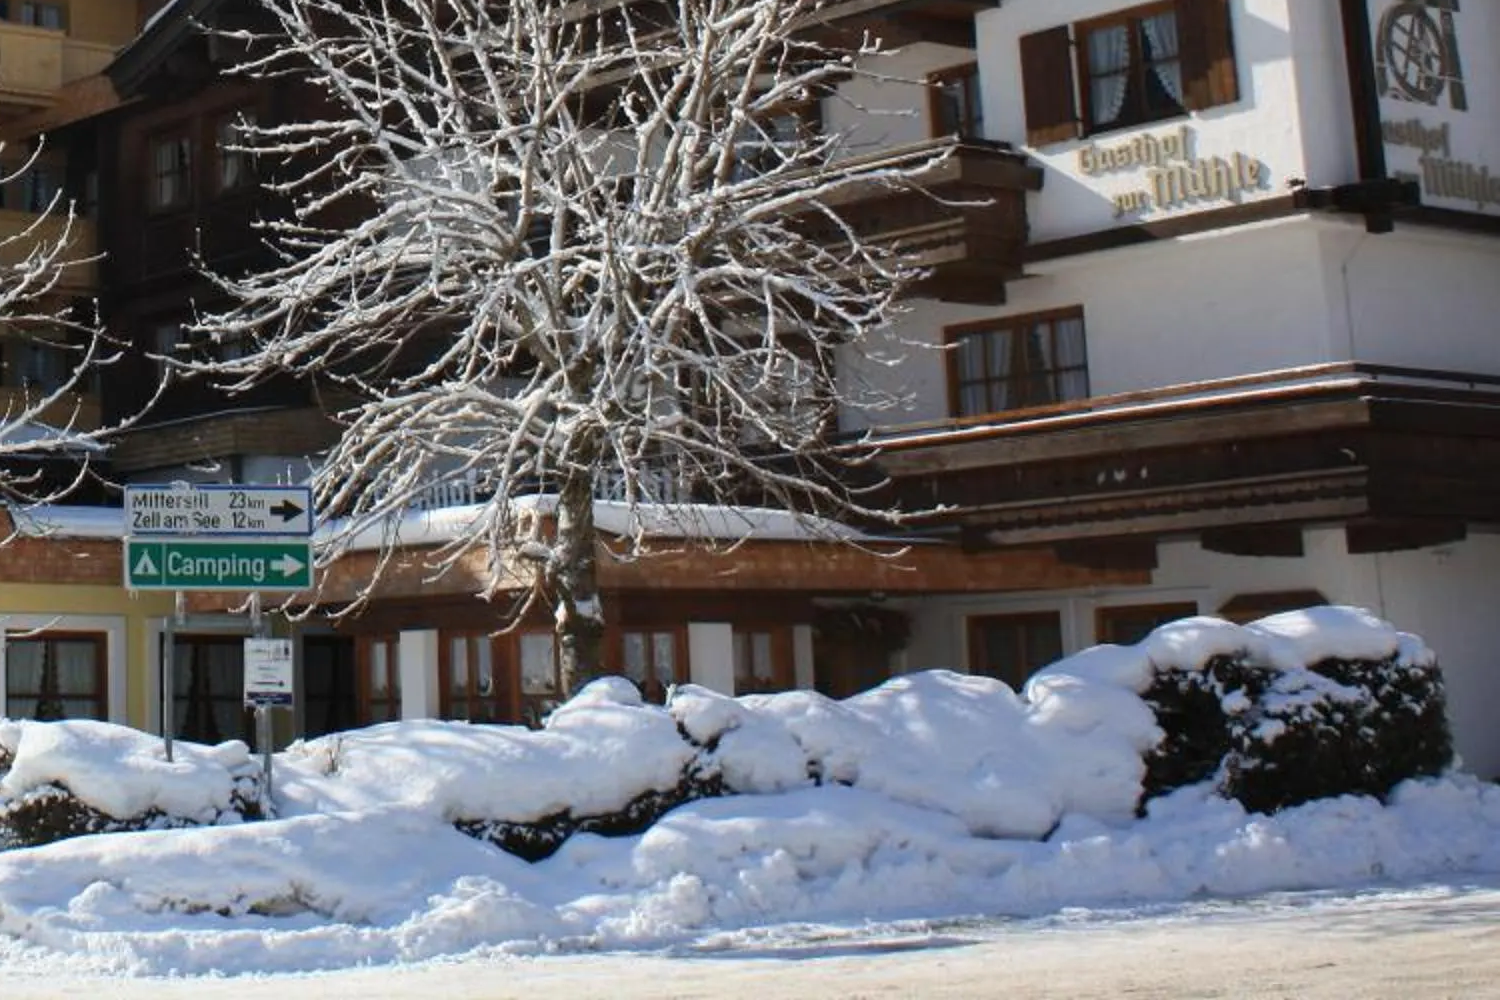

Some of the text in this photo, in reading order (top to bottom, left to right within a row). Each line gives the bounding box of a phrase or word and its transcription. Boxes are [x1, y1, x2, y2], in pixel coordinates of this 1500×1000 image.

[1076, 125, 1190, 175] Gasthof
[1379, 118, 1451, 157] asthof
[1112, 190, 1147, 217] zur
[132, 492, 265, 509] Mittersill 23 km
[132, 511, 265, 529] Zell am See 12 km
[168, 551, 265, 582] Camping
